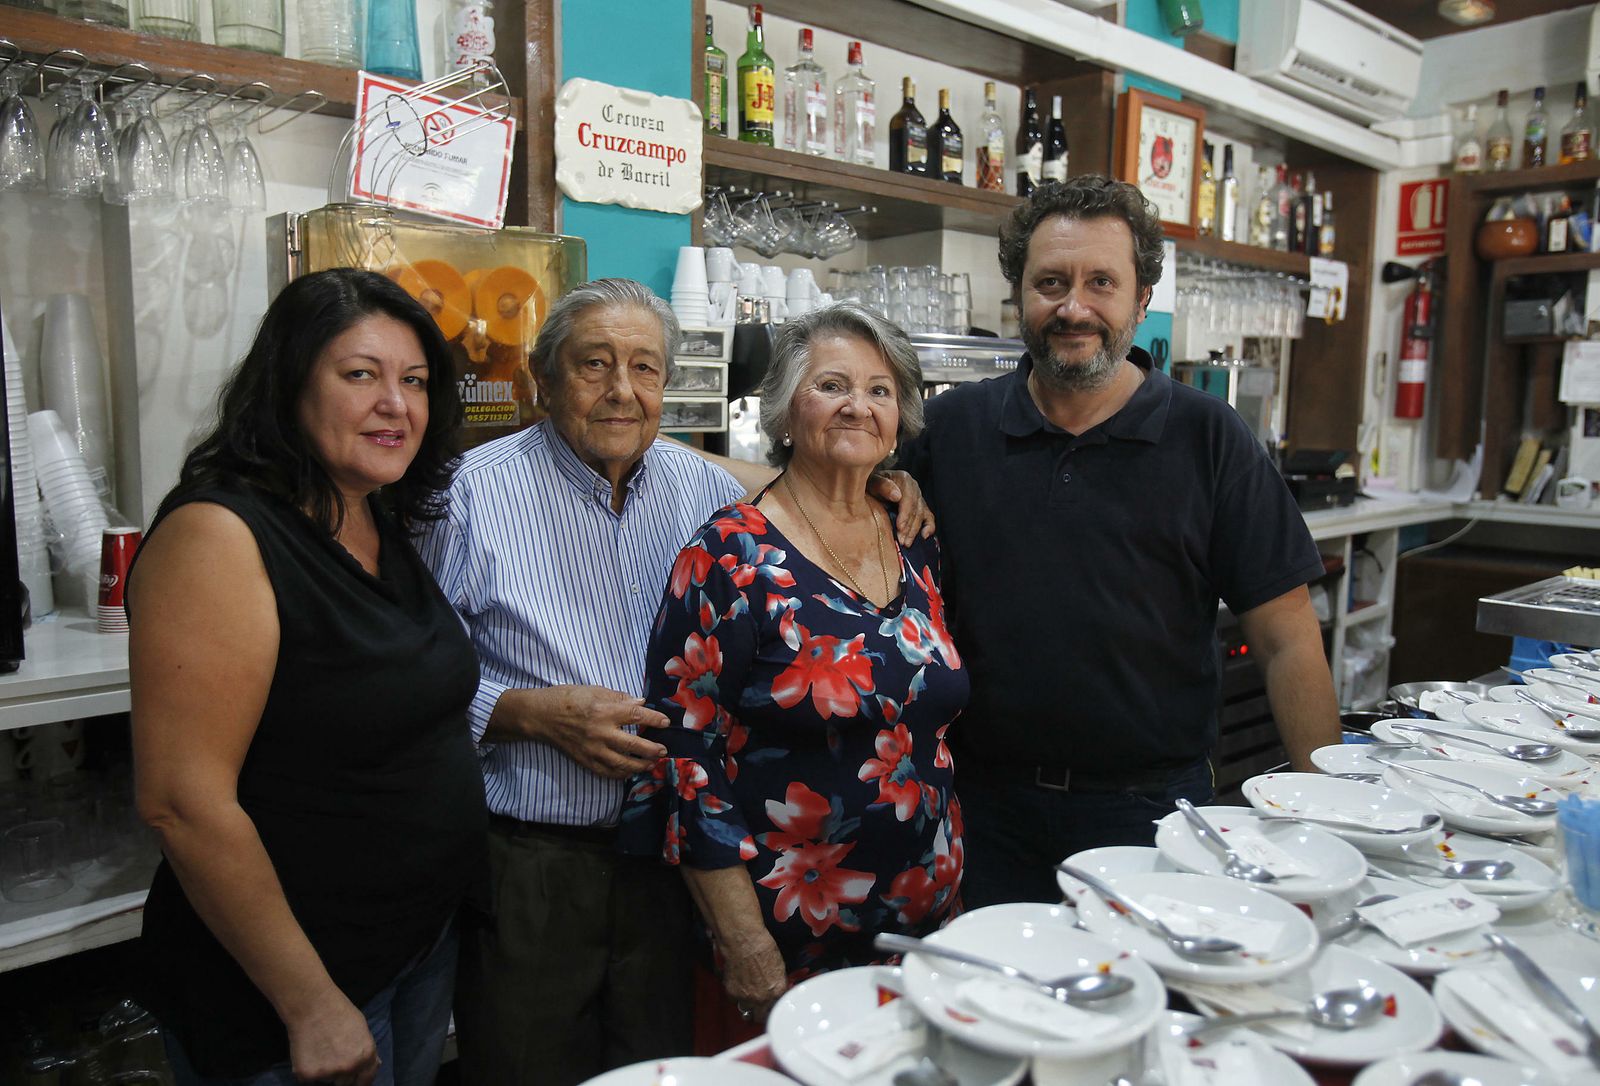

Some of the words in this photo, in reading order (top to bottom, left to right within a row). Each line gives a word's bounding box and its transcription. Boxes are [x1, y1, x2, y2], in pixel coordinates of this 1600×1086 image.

[601, 104, 665, 133] Cerveza
[577, 122, 687, 168] Cruzcampo
[597, 159, 615, 179] de
[620, 161, 671, 188] Barril
[464, 405, 516, 413] DELEGACION
